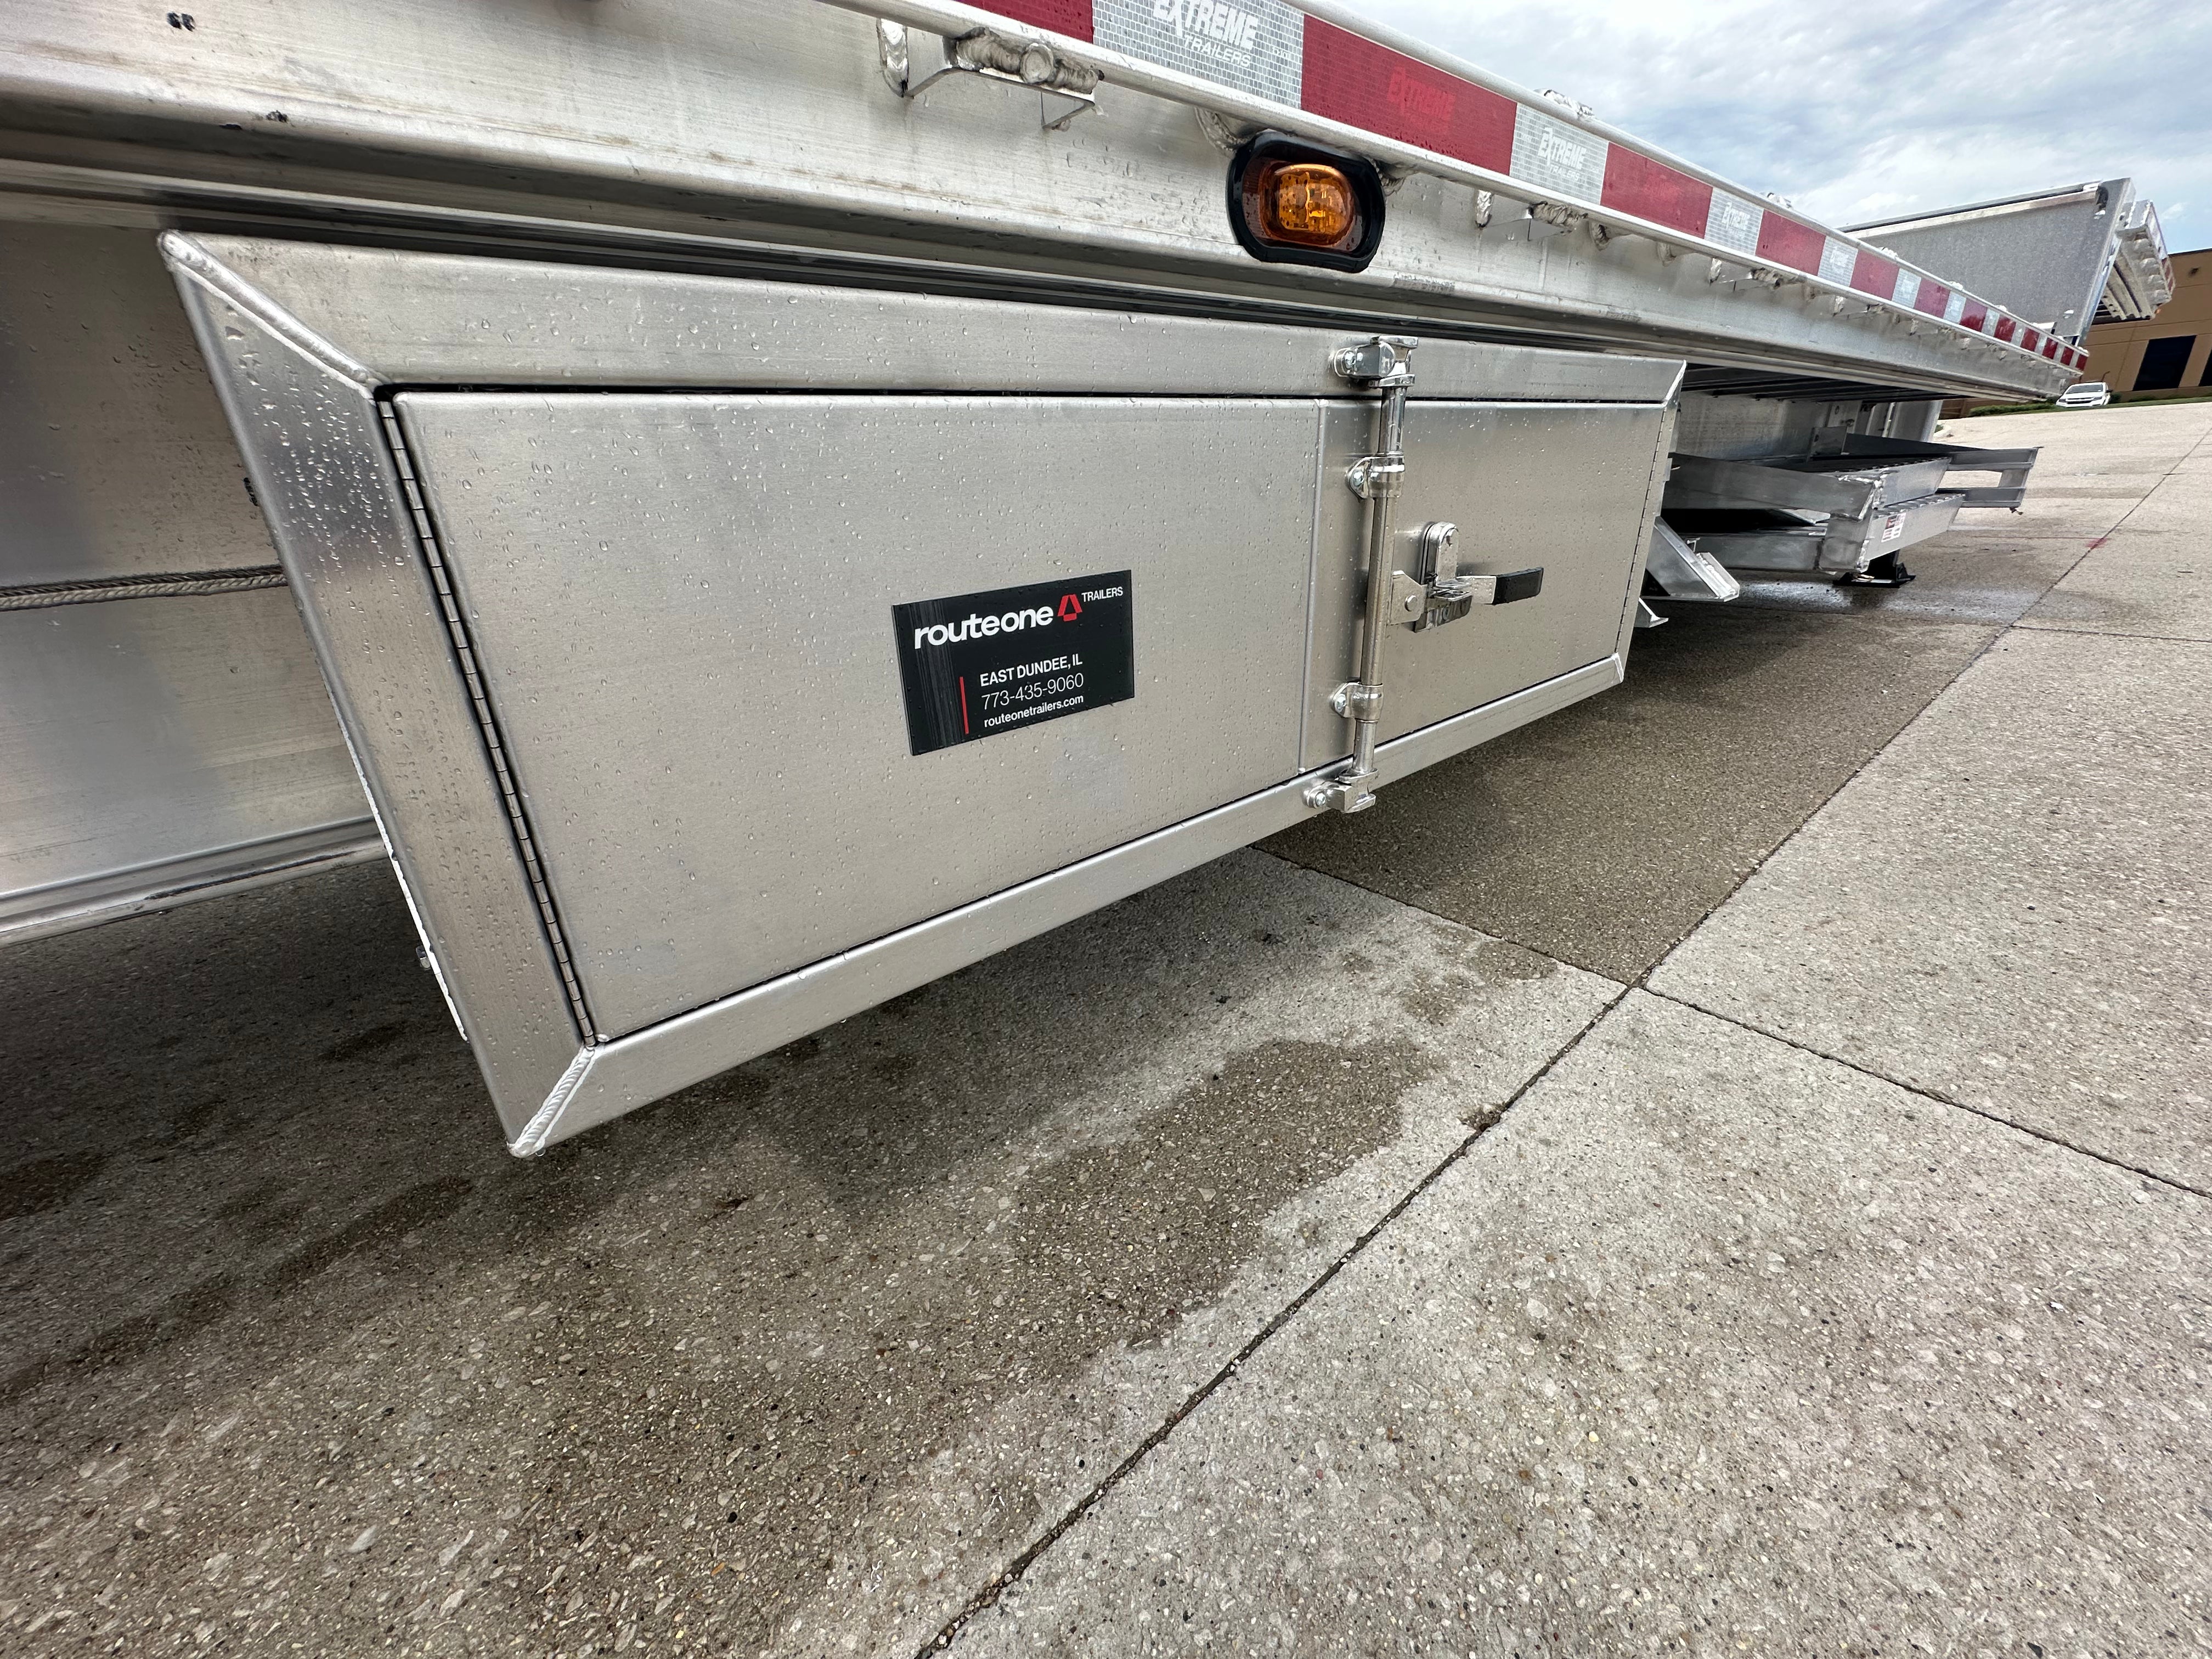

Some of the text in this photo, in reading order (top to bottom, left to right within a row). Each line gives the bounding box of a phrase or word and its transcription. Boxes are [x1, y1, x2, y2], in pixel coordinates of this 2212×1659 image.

[1153, 0, 1259, 50] EXTREME
[1184, 35, 1251, 67] TRAILERS
[1537, 127, 1587, 170] EXTREME
[1549, 165, 1580, 181] TRAILERS
[915, 586, 1123, 649] routeone TRAILERS
[980, 653, 1083, 686] EAST DUNDEE, IL
[981, 673, 1084, 710] 773-435-9060
[984, 695, 1084, 727] routeonetrailers.com
